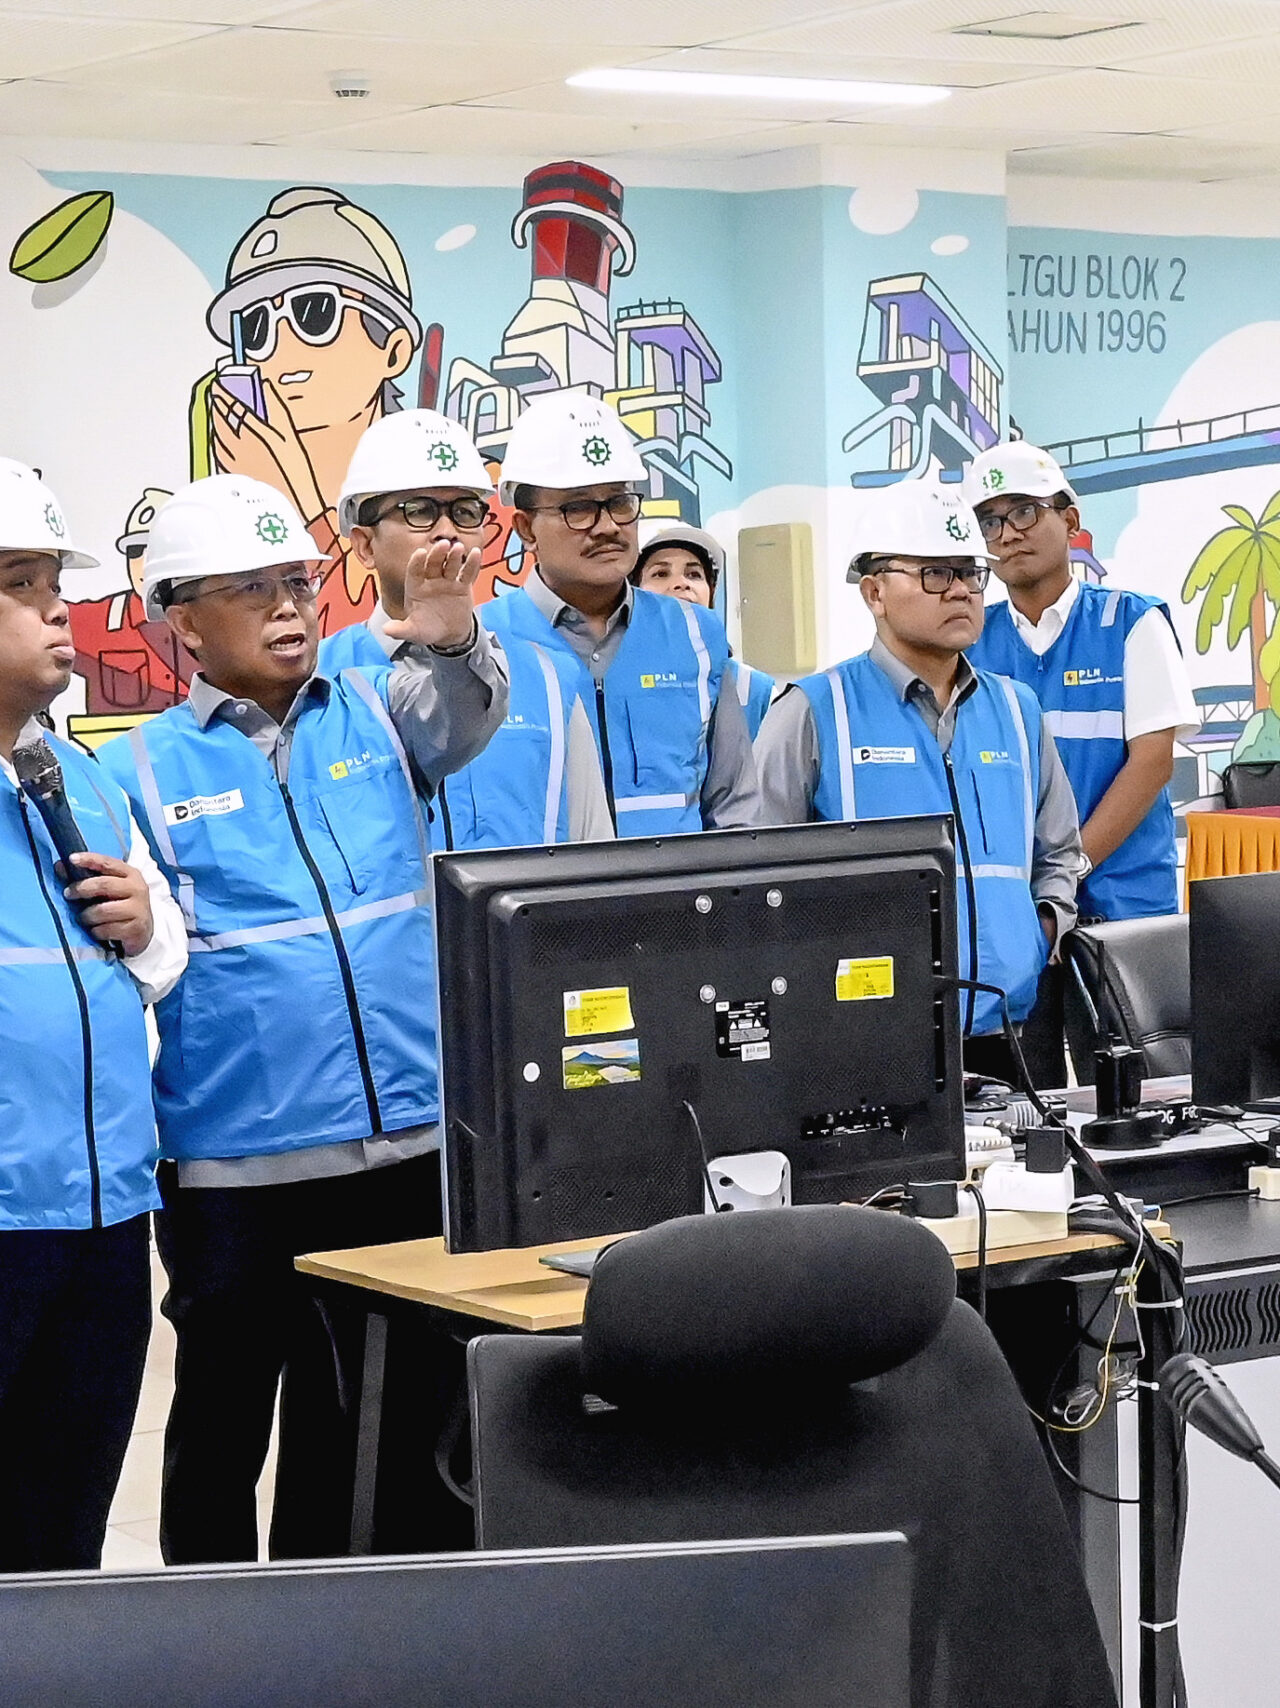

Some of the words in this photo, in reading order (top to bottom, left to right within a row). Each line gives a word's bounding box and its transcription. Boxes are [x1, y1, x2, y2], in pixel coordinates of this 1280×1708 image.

[1086, 255, 1159, 301] BLOK
[1170, 257, 1187, 302] 2
[1096, 309, 1167, 354] 1996
[654, 672, 677, 681] PLN
[1078, 668, 1101, 678] PLN
[346, 750, 371, 768] PLN
